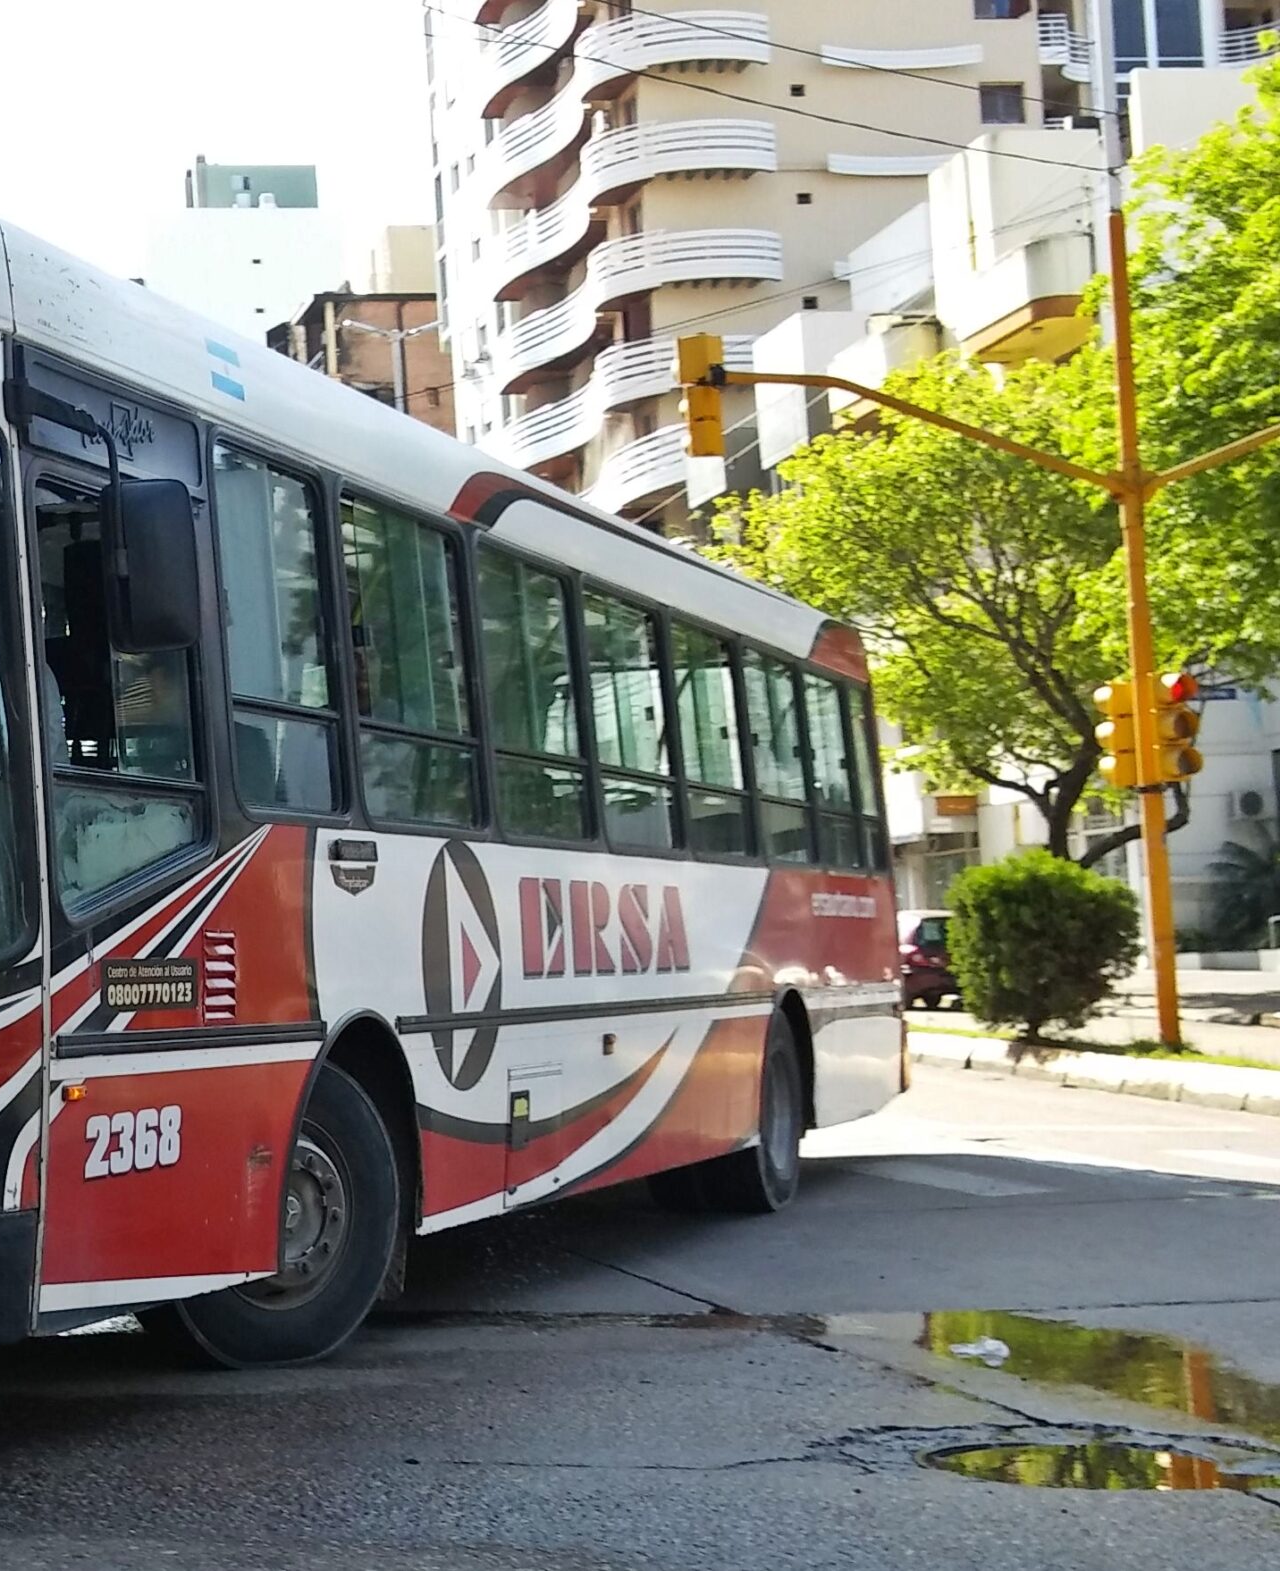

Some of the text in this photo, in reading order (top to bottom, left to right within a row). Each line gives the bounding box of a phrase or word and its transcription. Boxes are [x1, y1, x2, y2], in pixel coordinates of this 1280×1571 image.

[519, 876, 691, 979] ERSA
[107, 964, 192, 978] Centro de Atención al Usuario
[107, 982, 192, 1006] 08007770123
[84, 1105, 182, 1181] 2368
